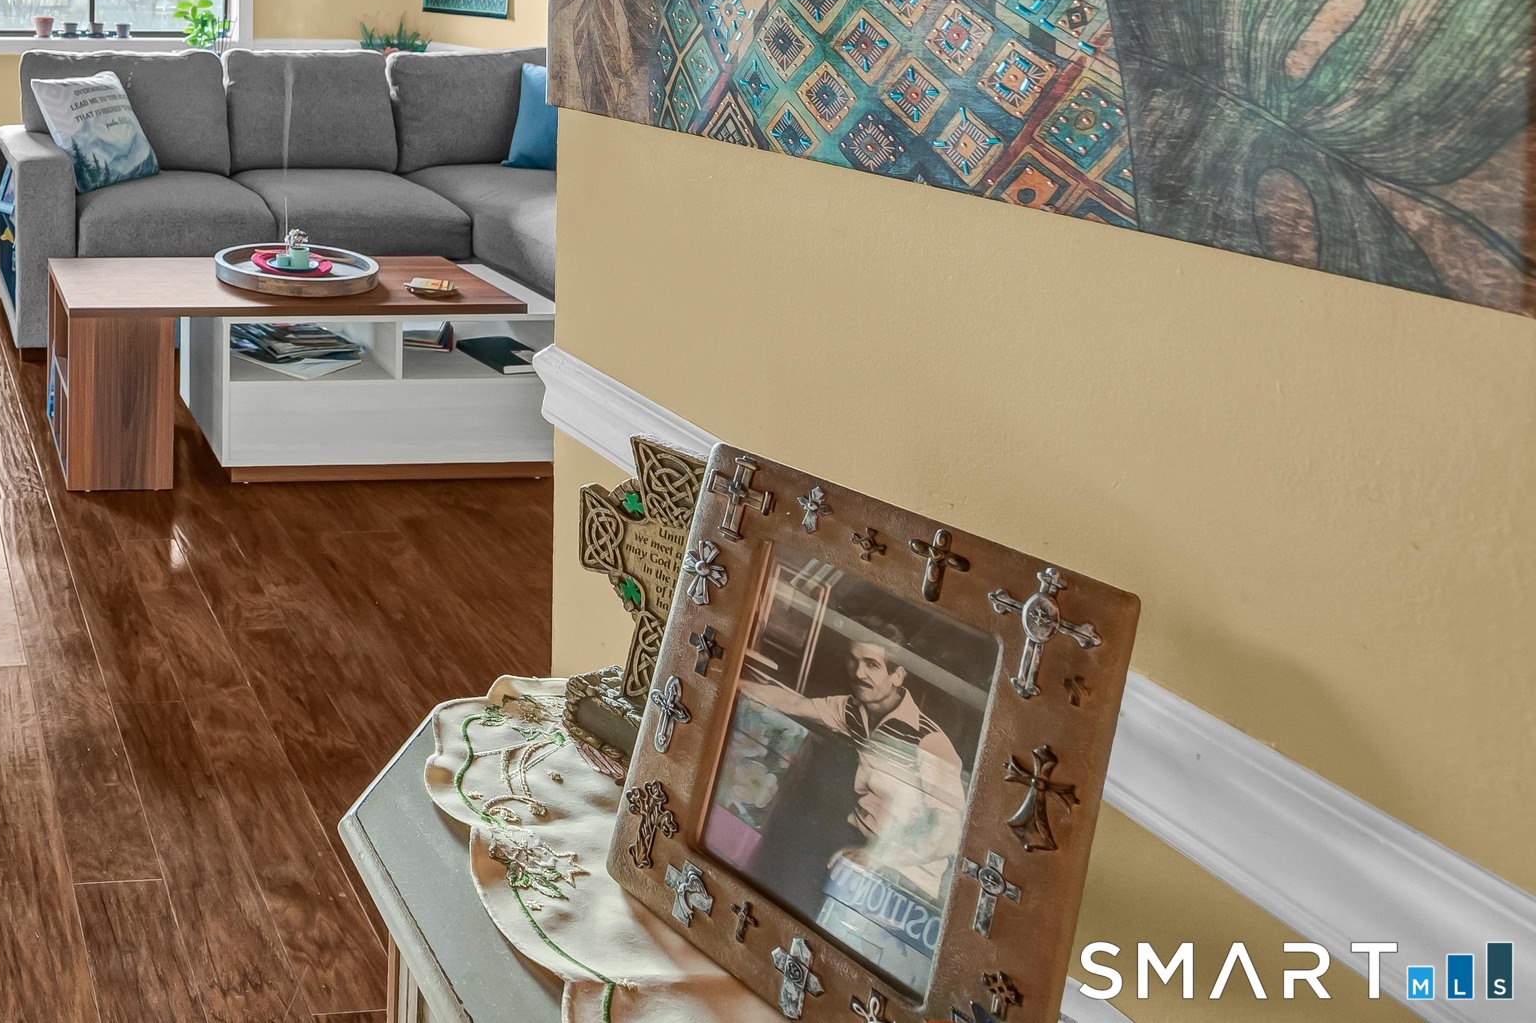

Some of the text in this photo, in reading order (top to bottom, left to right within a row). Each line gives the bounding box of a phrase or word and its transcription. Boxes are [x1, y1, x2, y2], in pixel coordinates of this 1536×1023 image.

[70, 99, 89, 111] LEAD
[74, 111, 95, 123] THAT
[635, 533, 673, 555] we meet
[658, 527, 684, 546] Until
[625, 543, 648, 560] may
[650, 553, 671, 570] God
[643, 563, 671, 583] in the
[656, 585, 668, 598] of
